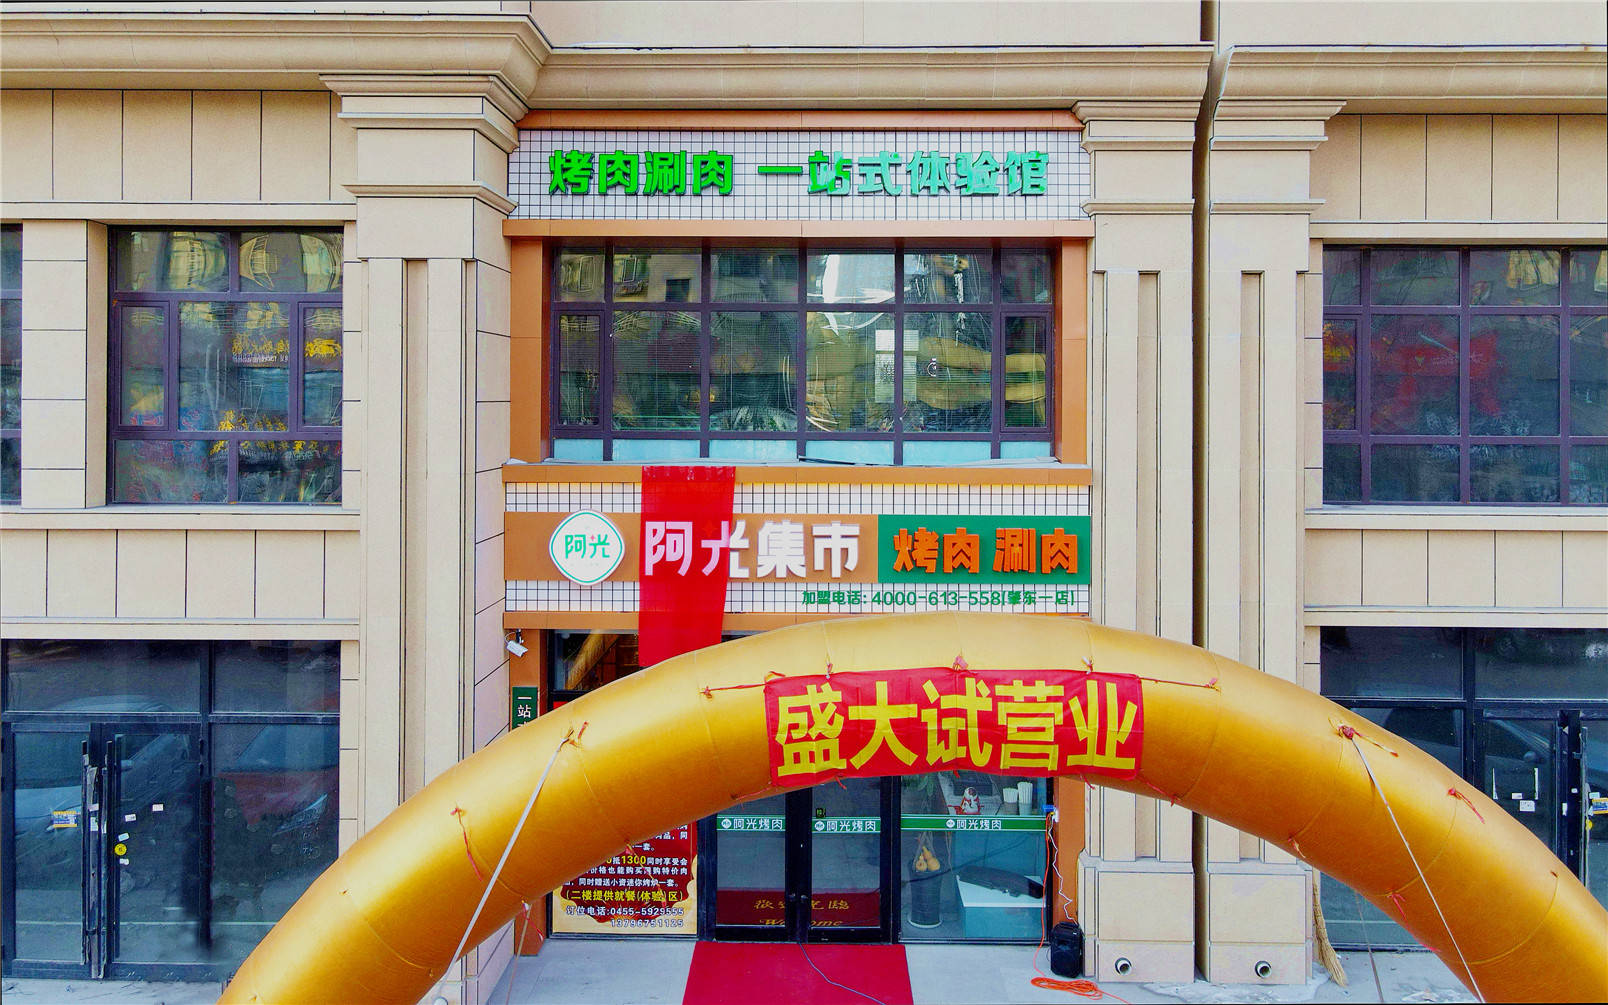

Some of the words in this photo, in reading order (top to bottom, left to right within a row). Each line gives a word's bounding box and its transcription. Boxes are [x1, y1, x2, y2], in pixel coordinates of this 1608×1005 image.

[549, 150, 734, 195] 烤肉涮肉
[758, 150, 1050, 196] 一站式体验馆
[564, 533, 610, 559] 阿光
[644, 519, 861, 579] 阿光集市
[893, 527, 980, 574] 烤肉
[992, 527, 1078, 574] 涮肉
[517, 696, 532, 727] 一站
[775, 677, 1137, 777] 盛大试营业
[733, 818, 783, 830] 阿光烤肉
[826, 820, 876, 832] 阿光烤肉
[956, 819, 1001, 830] 阿光烤肉
